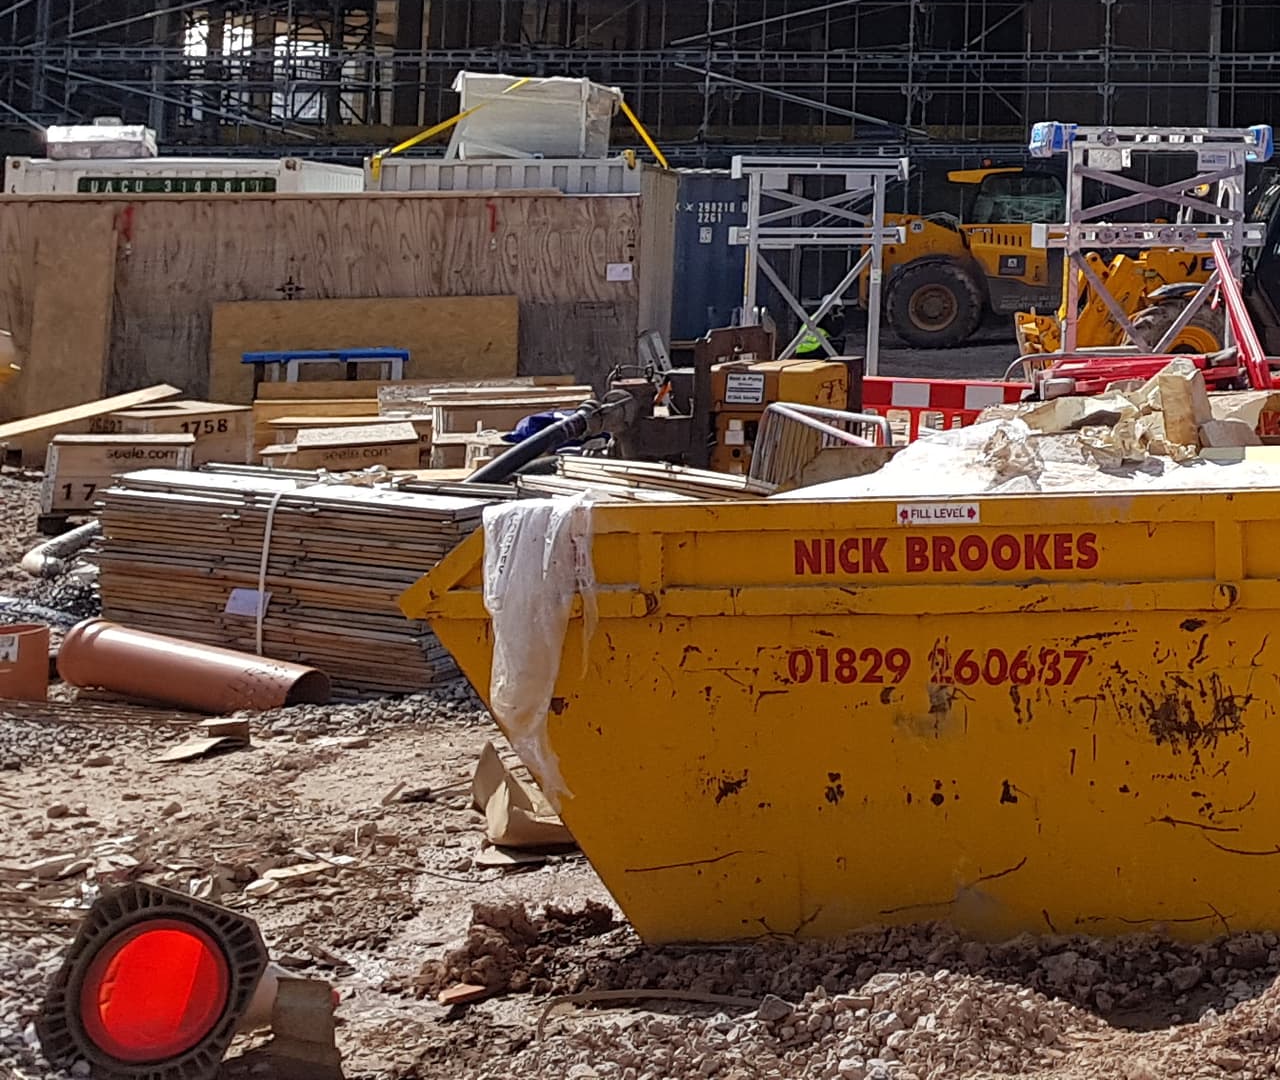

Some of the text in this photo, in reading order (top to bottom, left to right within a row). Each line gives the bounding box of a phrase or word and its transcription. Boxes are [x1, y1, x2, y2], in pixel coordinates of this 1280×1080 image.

[180, 419, 228, 435] 1758
[106, 446, 178, 460] seele.com
[911, 507, 965, 519] FILL LEVEL
[794, 532, 1099, 576] NICK BROOKES
[788, 647, 911, 685] 01829
